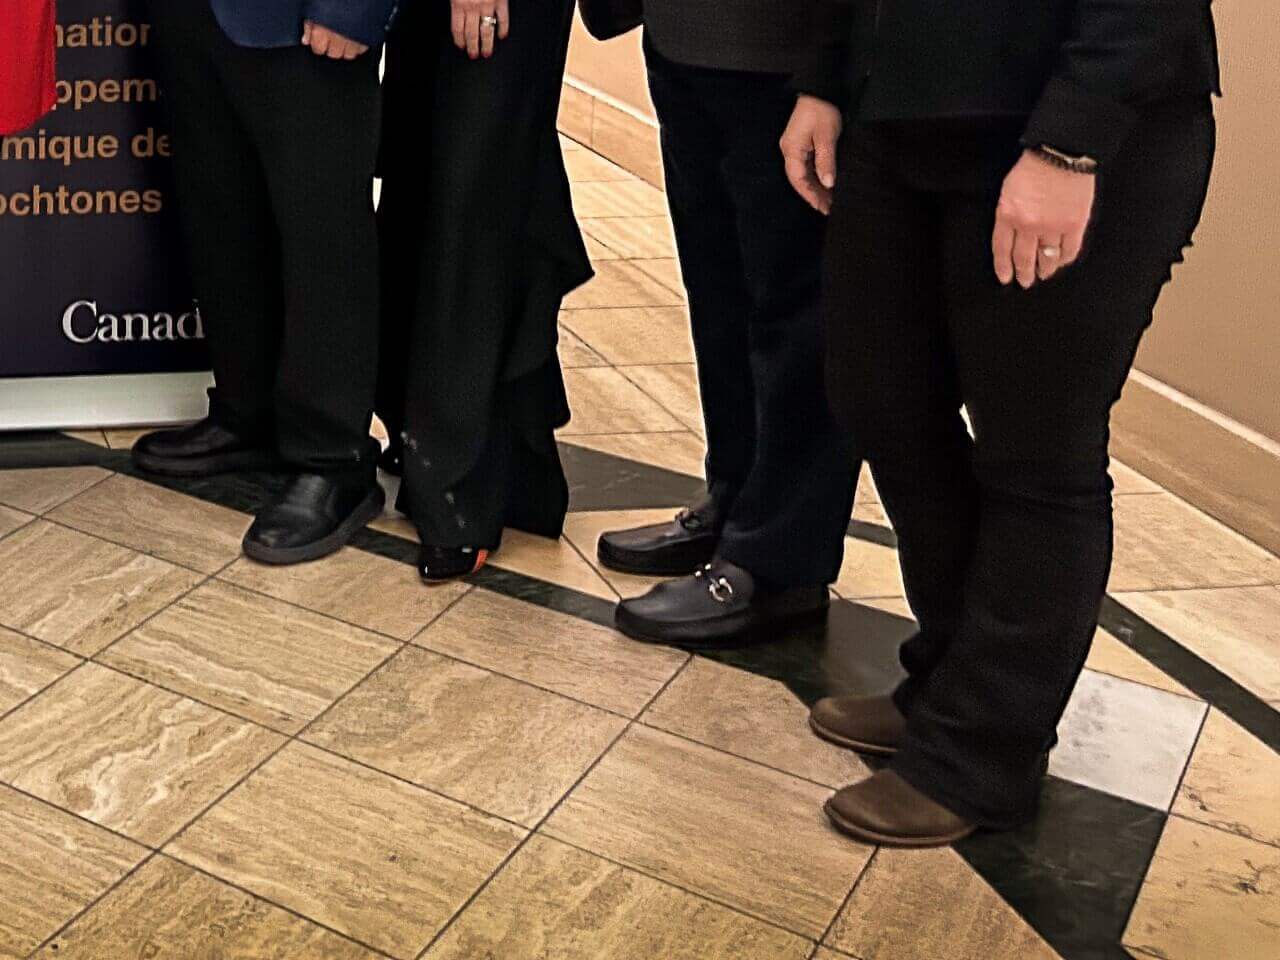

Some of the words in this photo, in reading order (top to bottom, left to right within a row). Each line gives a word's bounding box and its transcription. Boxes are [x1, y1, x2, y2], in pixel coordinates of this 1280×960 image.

[0, 128, 120, 166] mique
[131, 127, 172, 159] de
[61, 298, 206, 344] Canad
